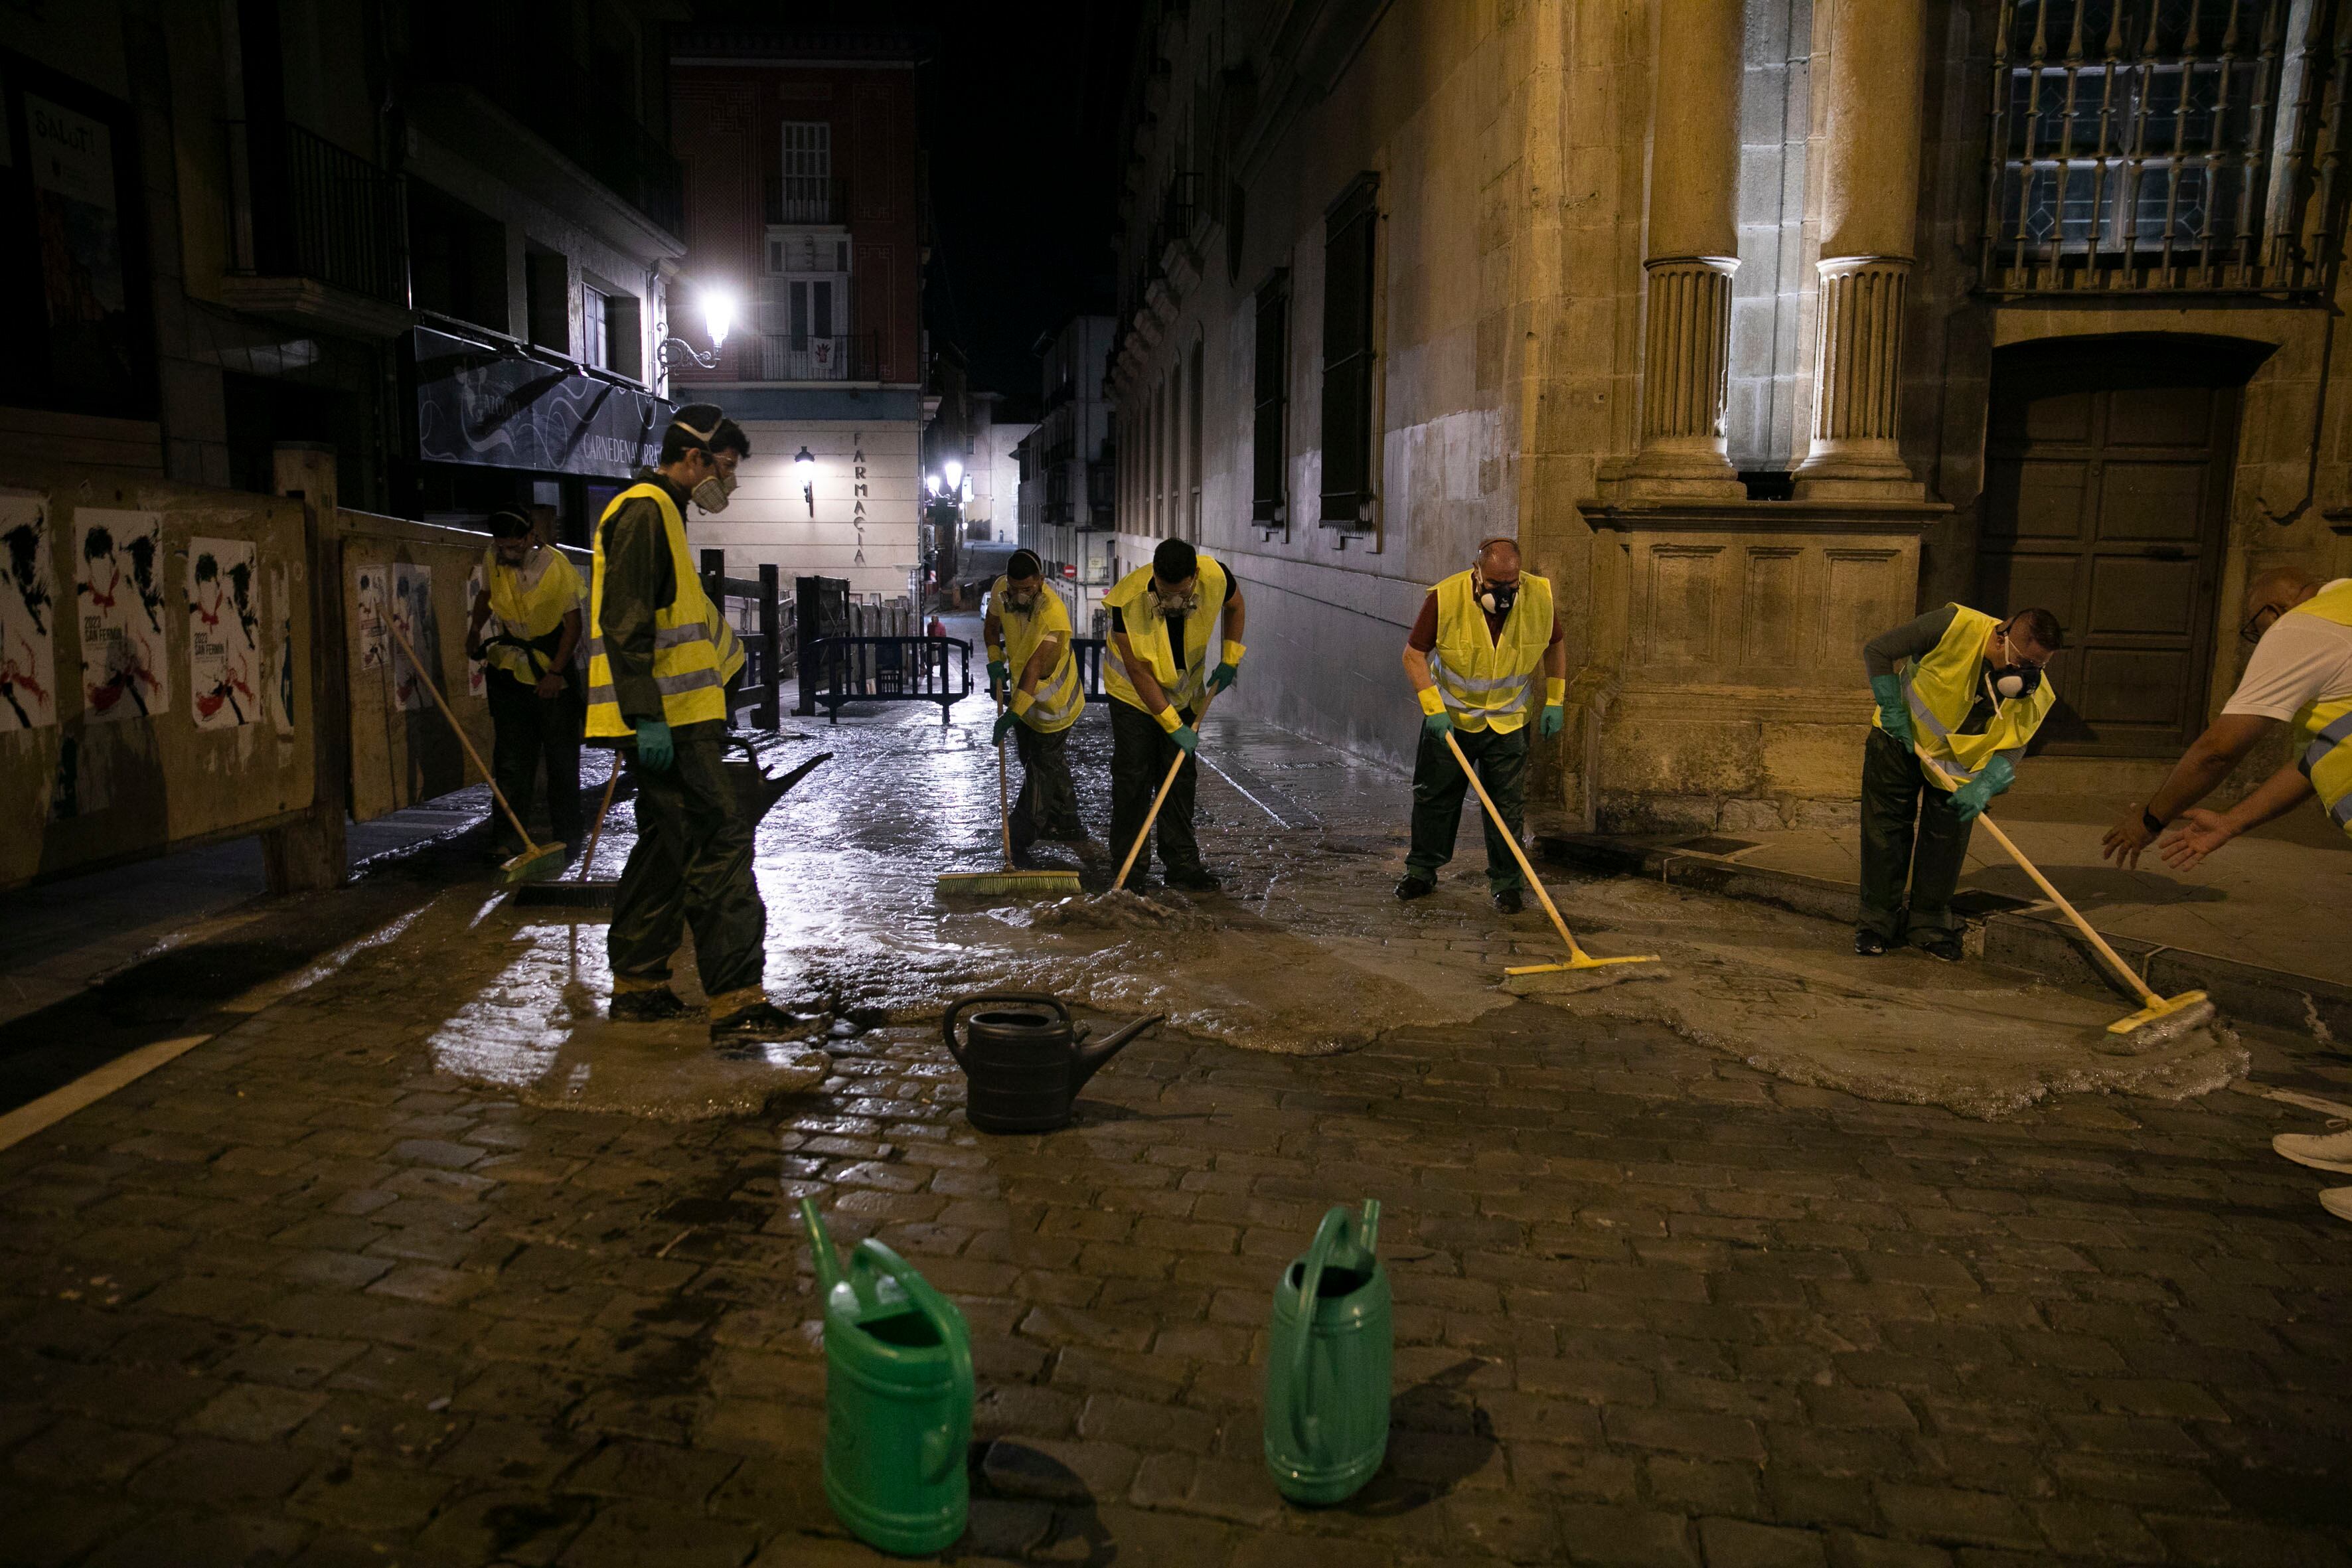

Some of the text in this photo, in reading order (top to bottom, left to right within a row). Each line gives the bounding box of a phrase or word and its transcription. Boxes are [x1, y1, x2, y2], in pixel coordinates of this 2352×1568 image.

[853, 433, 868, 566] FARMACIA
[85, 616, 102, 629] 2023
[85, 629, 98, 642] SAN
[195, 633, 208, 643] 2023
[195, 644, 205, 655] SAN
